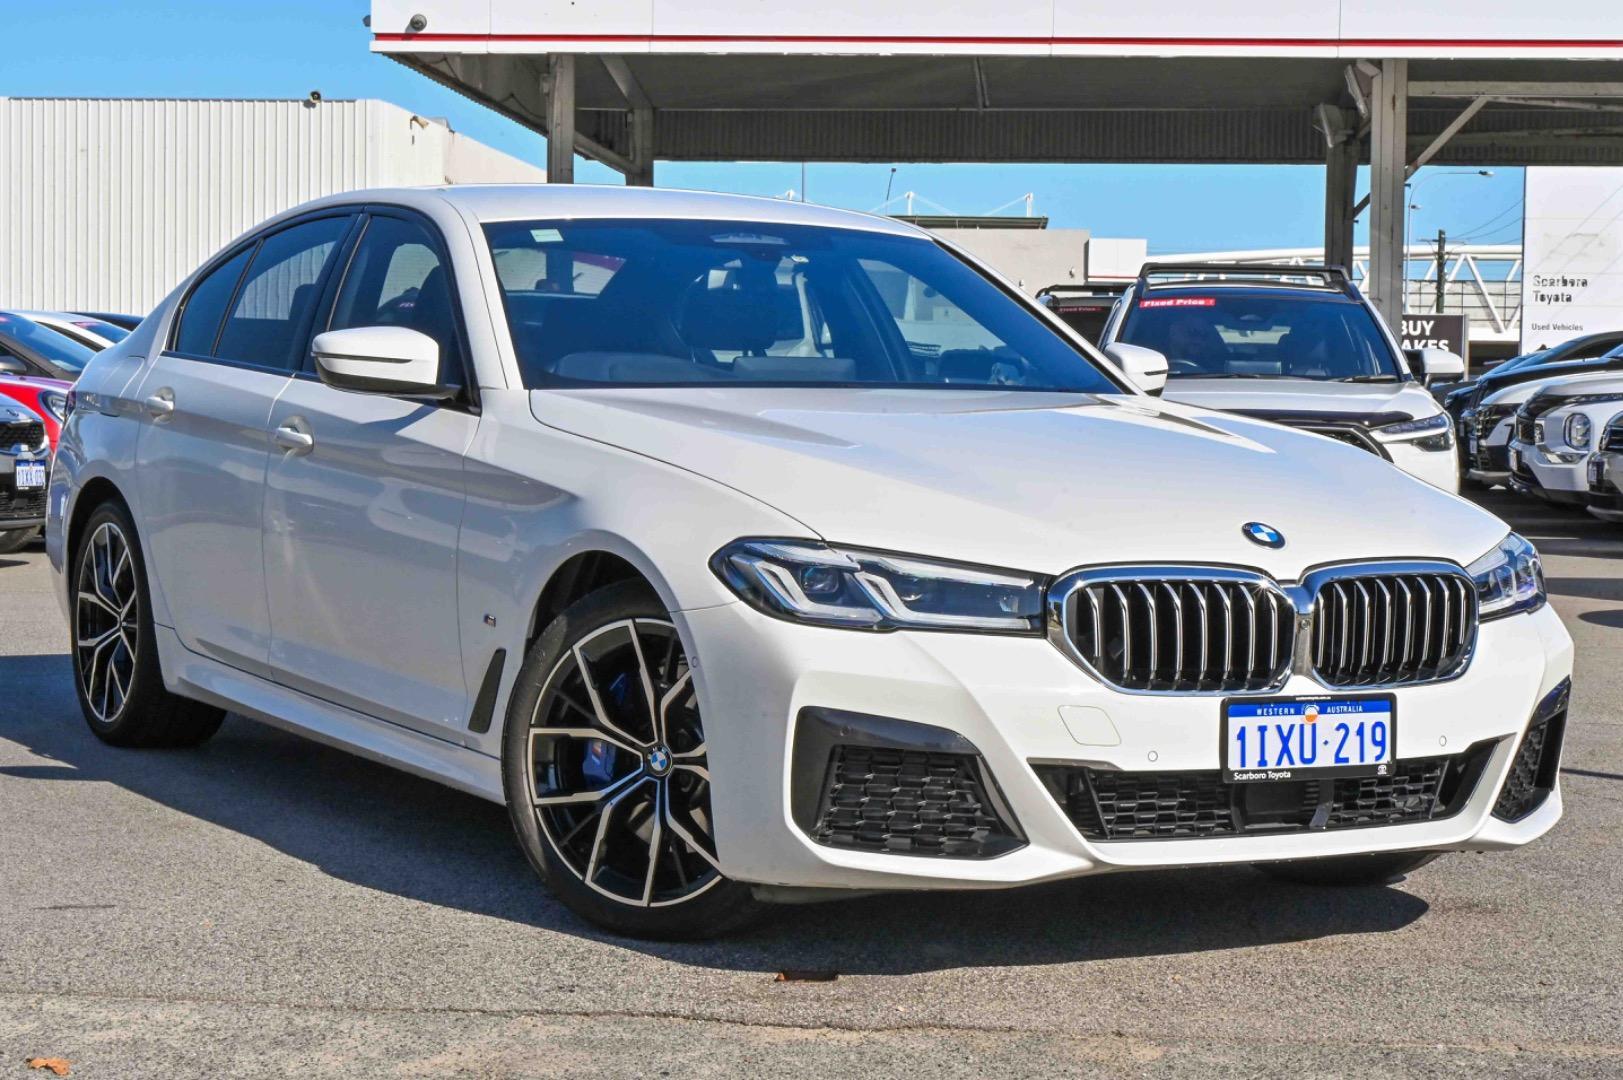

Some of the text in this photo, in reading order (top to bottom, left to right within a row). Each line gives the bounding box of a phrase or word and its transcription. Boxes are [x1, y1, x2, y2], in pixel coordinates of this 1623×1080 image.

[1533, 290, 1572, 305] Toyota
[1531, 323, 1584, 331] Used Vehicles
[1256, 705, 1363, 716] WESTERN AUSTRALIA
[1233, 771, 1292, 781] Scarboro Toyota
